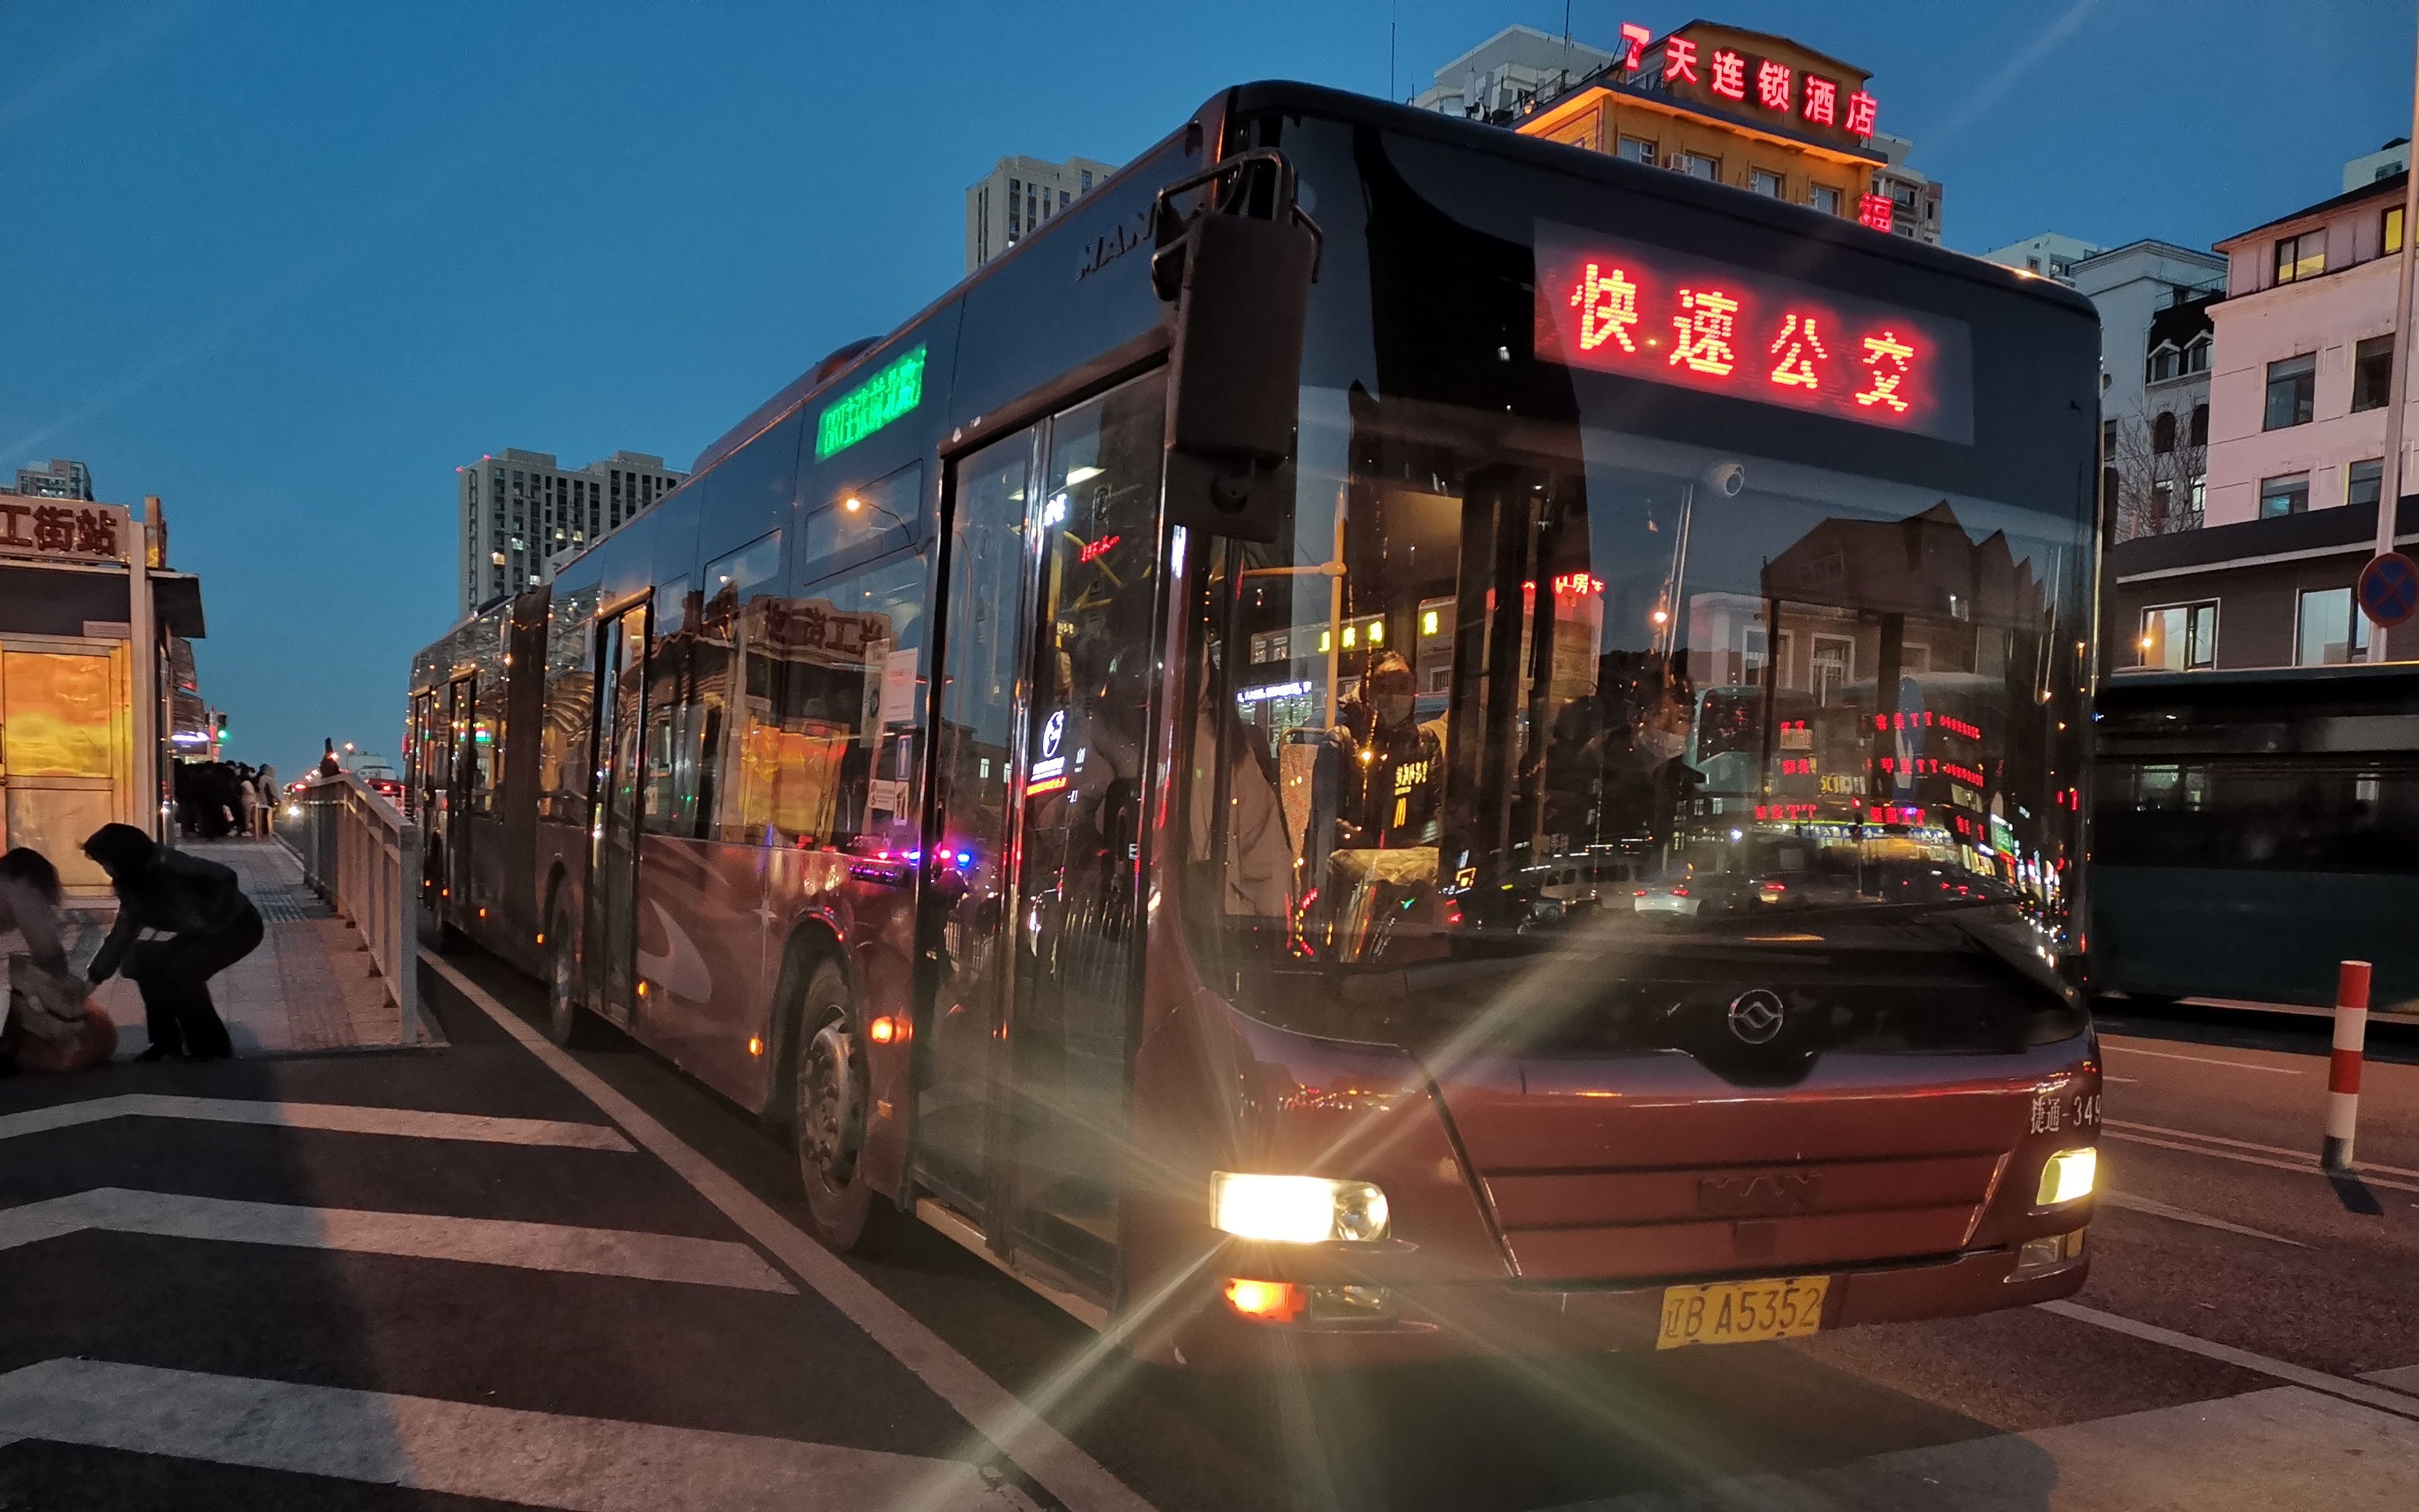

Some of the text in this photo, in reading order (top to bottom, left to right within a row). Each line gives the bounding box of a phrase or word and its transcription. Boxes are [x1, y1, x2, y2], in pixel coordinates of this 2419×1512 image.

[1621, 22, 1878, 137] 7天连锁酒店
[1571, 263, 1914, 412] 快速公交
[0, 504, 117, 556] 工街站
